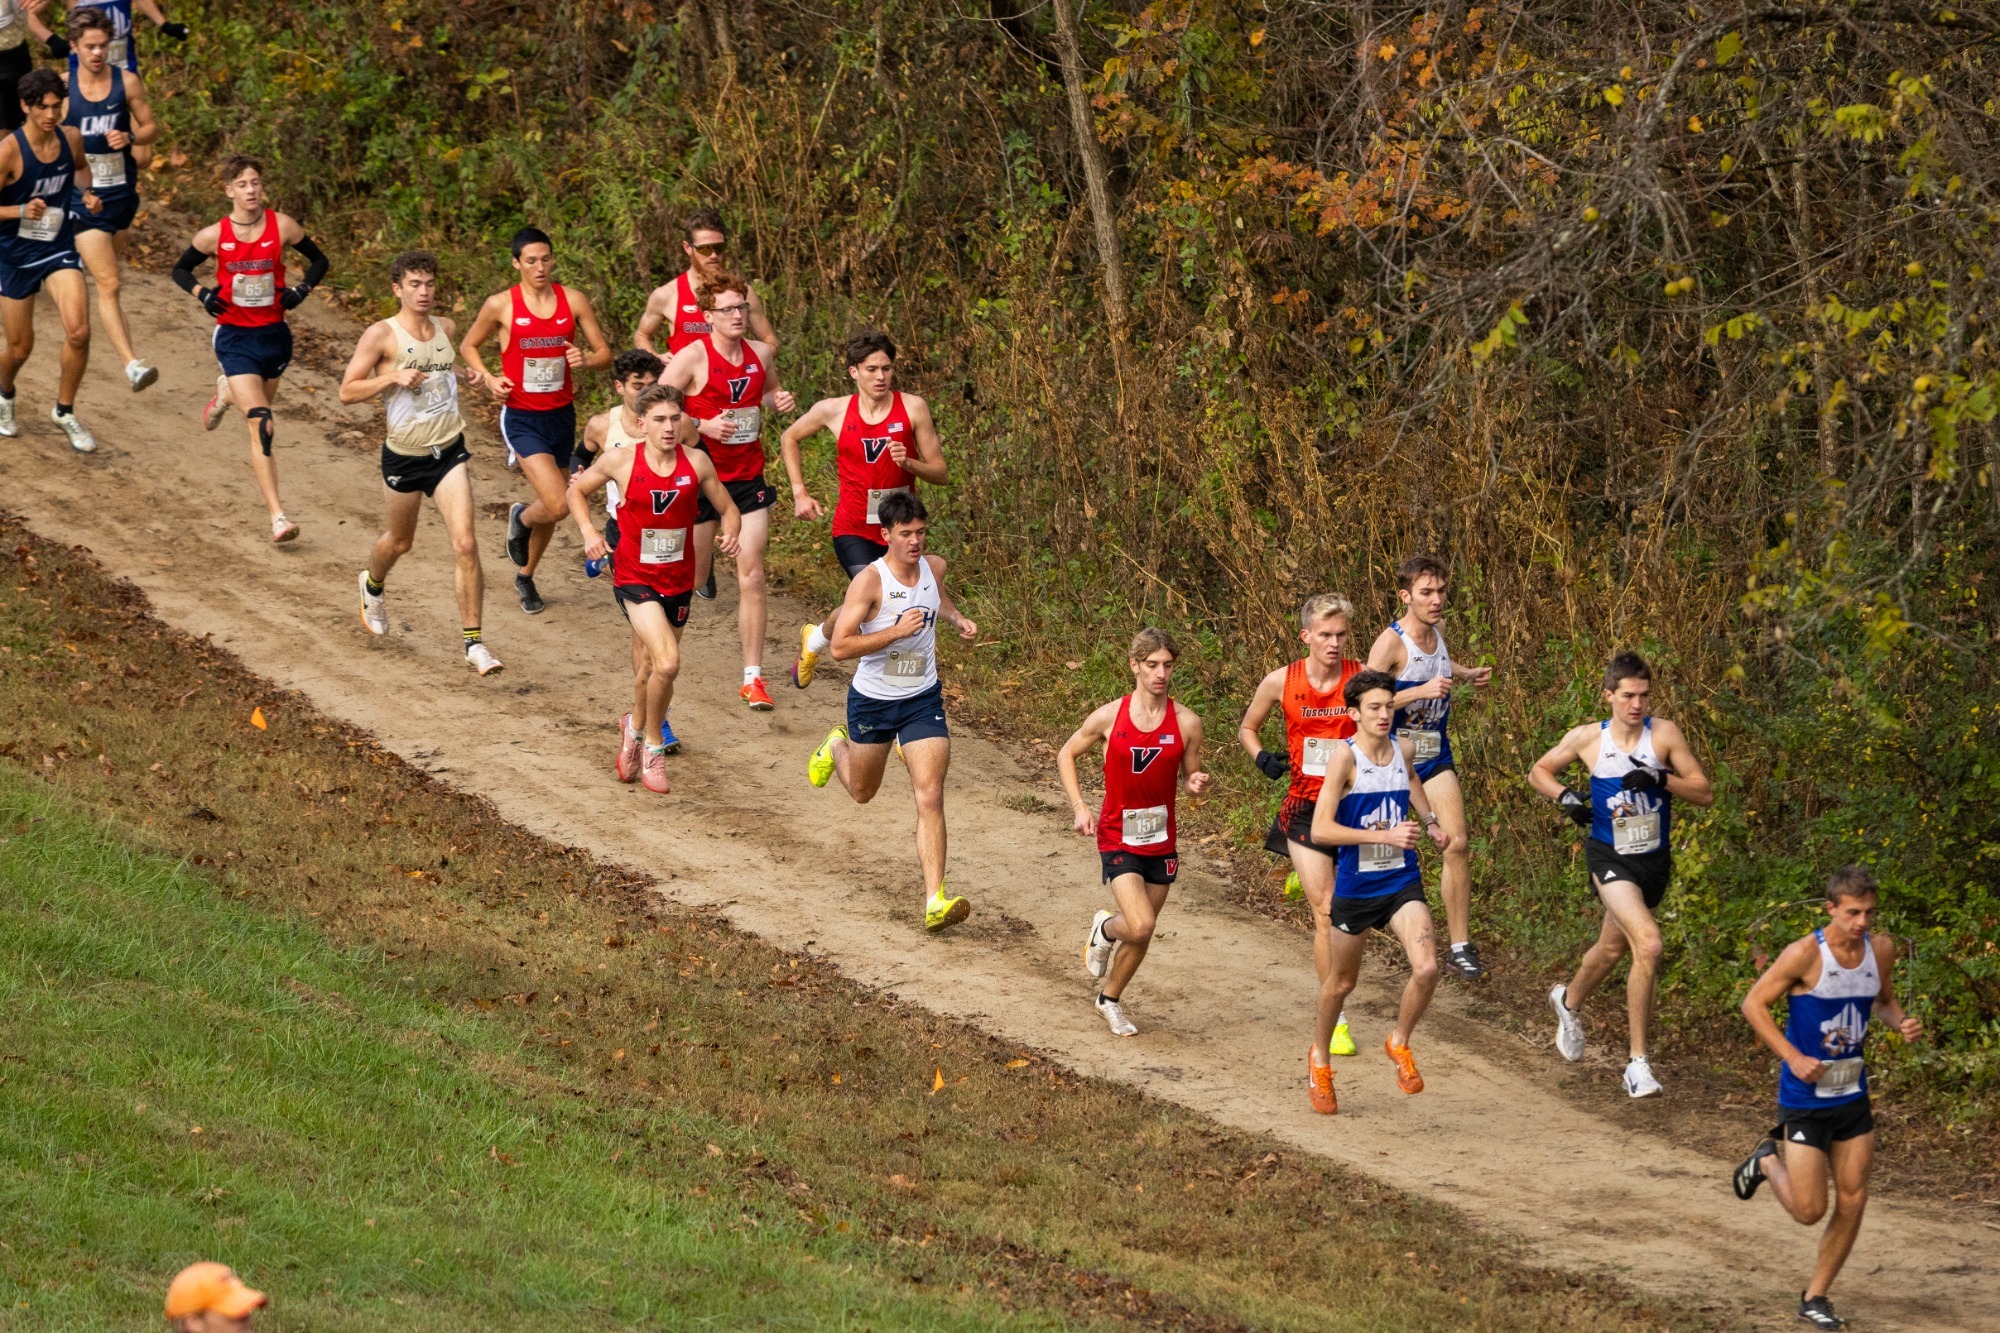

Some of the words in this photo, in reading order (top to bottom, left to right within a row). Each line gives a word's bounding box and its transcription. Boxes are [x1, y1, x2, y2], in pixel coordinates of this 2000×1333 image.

[81, 113, 119, 136] LMU
[30, 173, 69, 197] LMU
[245, 283, 262, 296] 65
[684, 321, 713, 334] CATA
[537, 366, 553, 381] 55
[425, 388, 441, 405] 23
[727, 376, 751, 404] V
[861, 436, 892, 464] V
[649, 489, 680, 515] V
[653, 538, 676, 552] 149
[889, 591, 907, 599] SAC
[897, 660, 917, 675] 173
[1413, 740, 1429, 753] 15
[1130, 746, 1162, 774] V
[1314, 748, 1334, 763] 21
[1136, 817, 1157, 833] 151
[1626, 825, 1649, 841] 116
[1165, 858, 1179, 875] V
